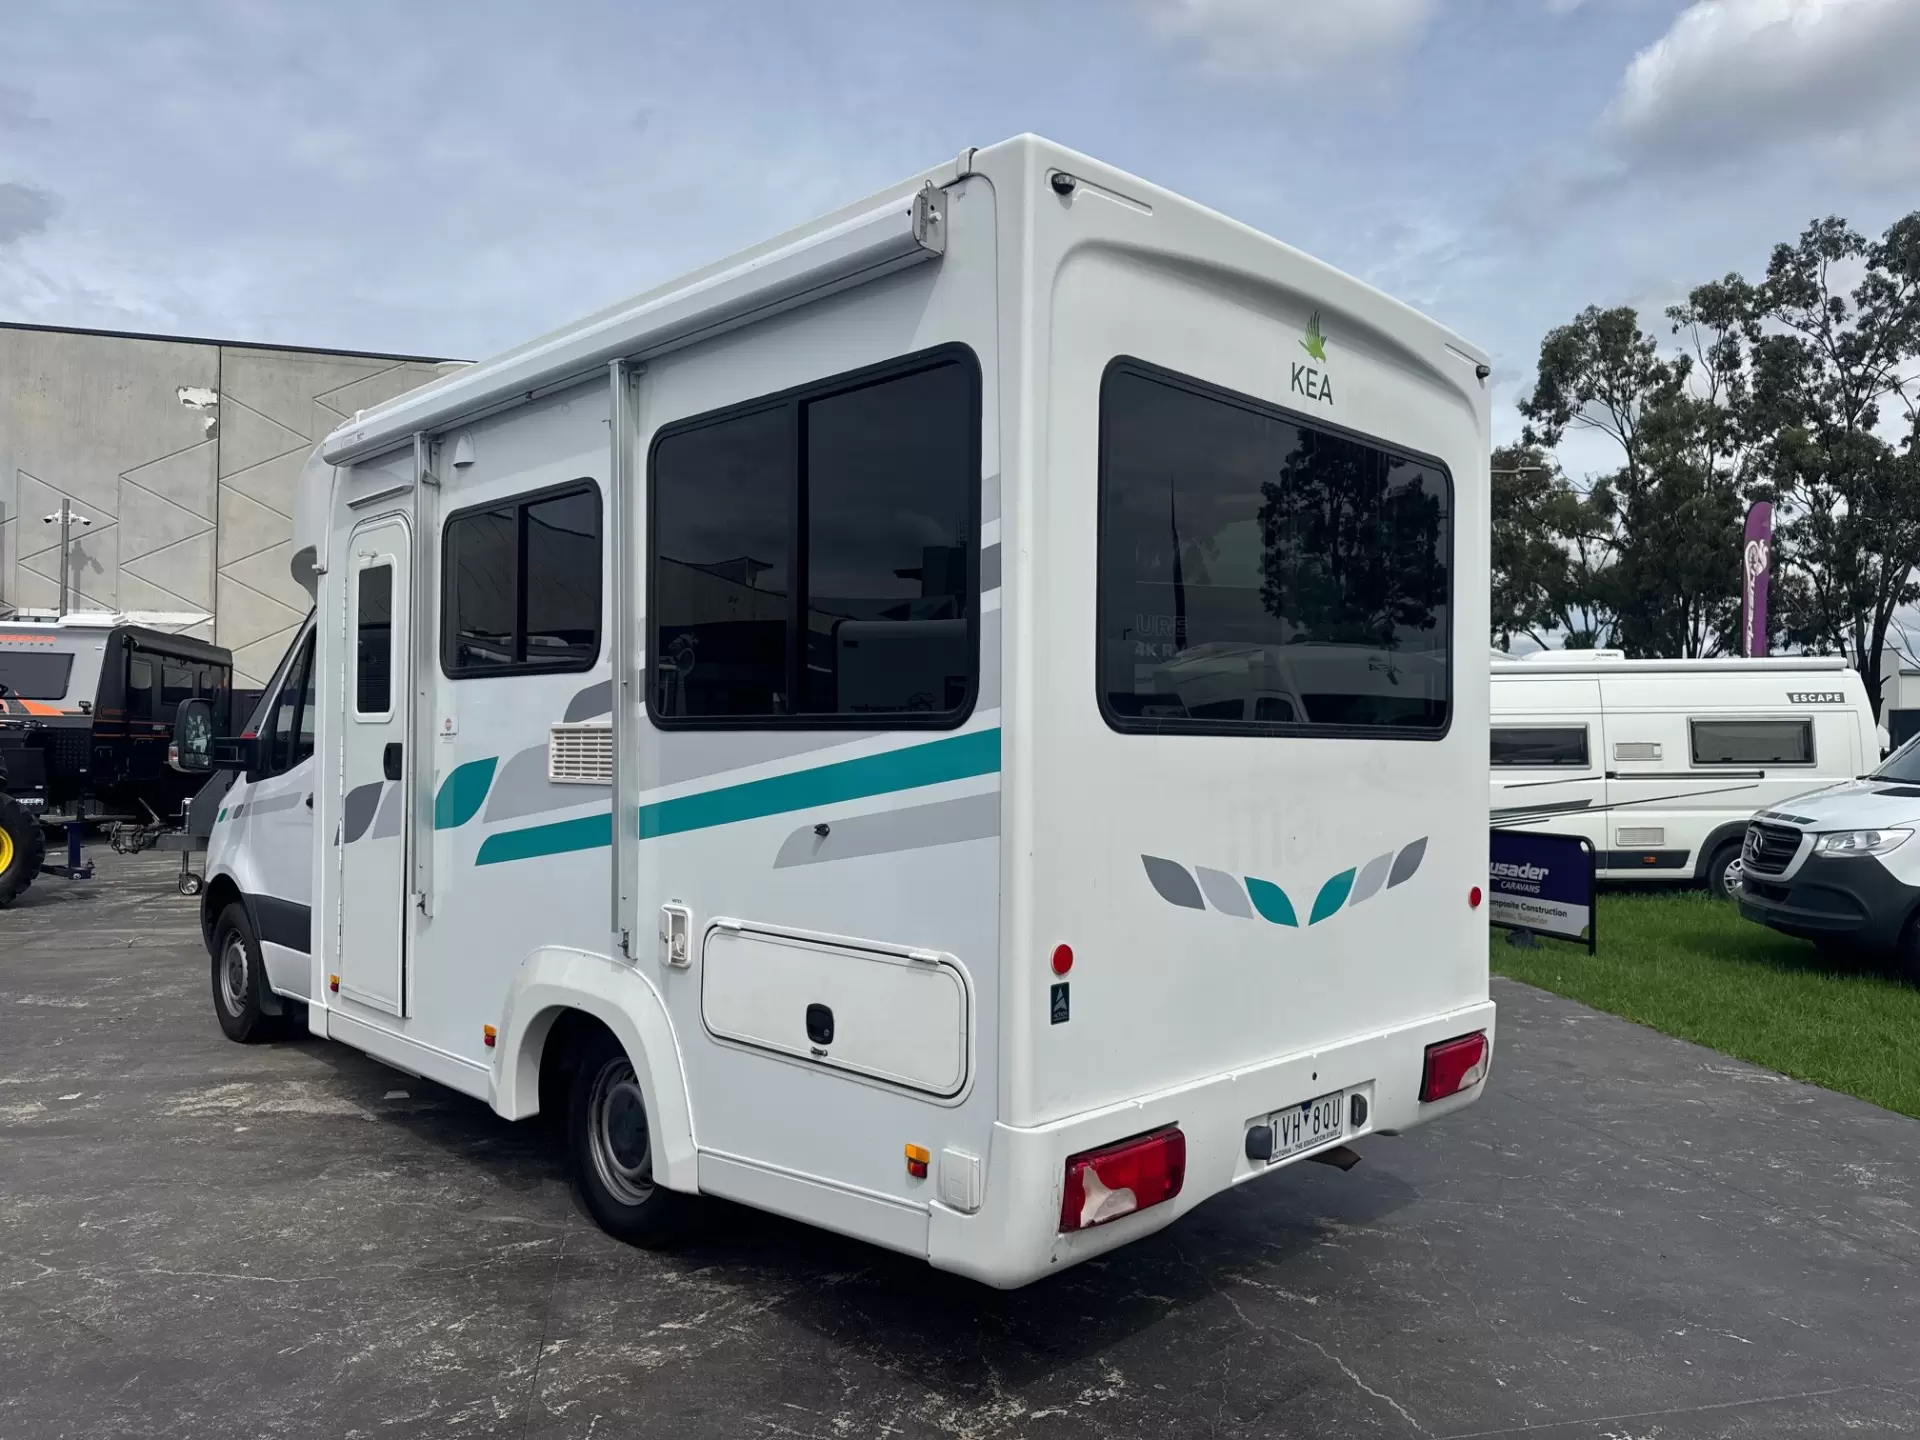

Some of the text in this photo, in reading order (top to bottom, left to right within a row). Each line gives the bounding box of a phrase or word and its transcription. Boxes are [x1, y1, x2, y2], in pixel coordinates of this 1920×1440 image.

[1291, 362, 1333, 405] KEA
[1792, 693, 1841, 702] ESCAPE
[1490, 862, 1549, 880] usader
[1501, 881, 1540, 893] CARAVANS
[1490, 900, 1567, 918] omposite Construction
[1273, 1098, 1339, 1150] 1VH 8QU
